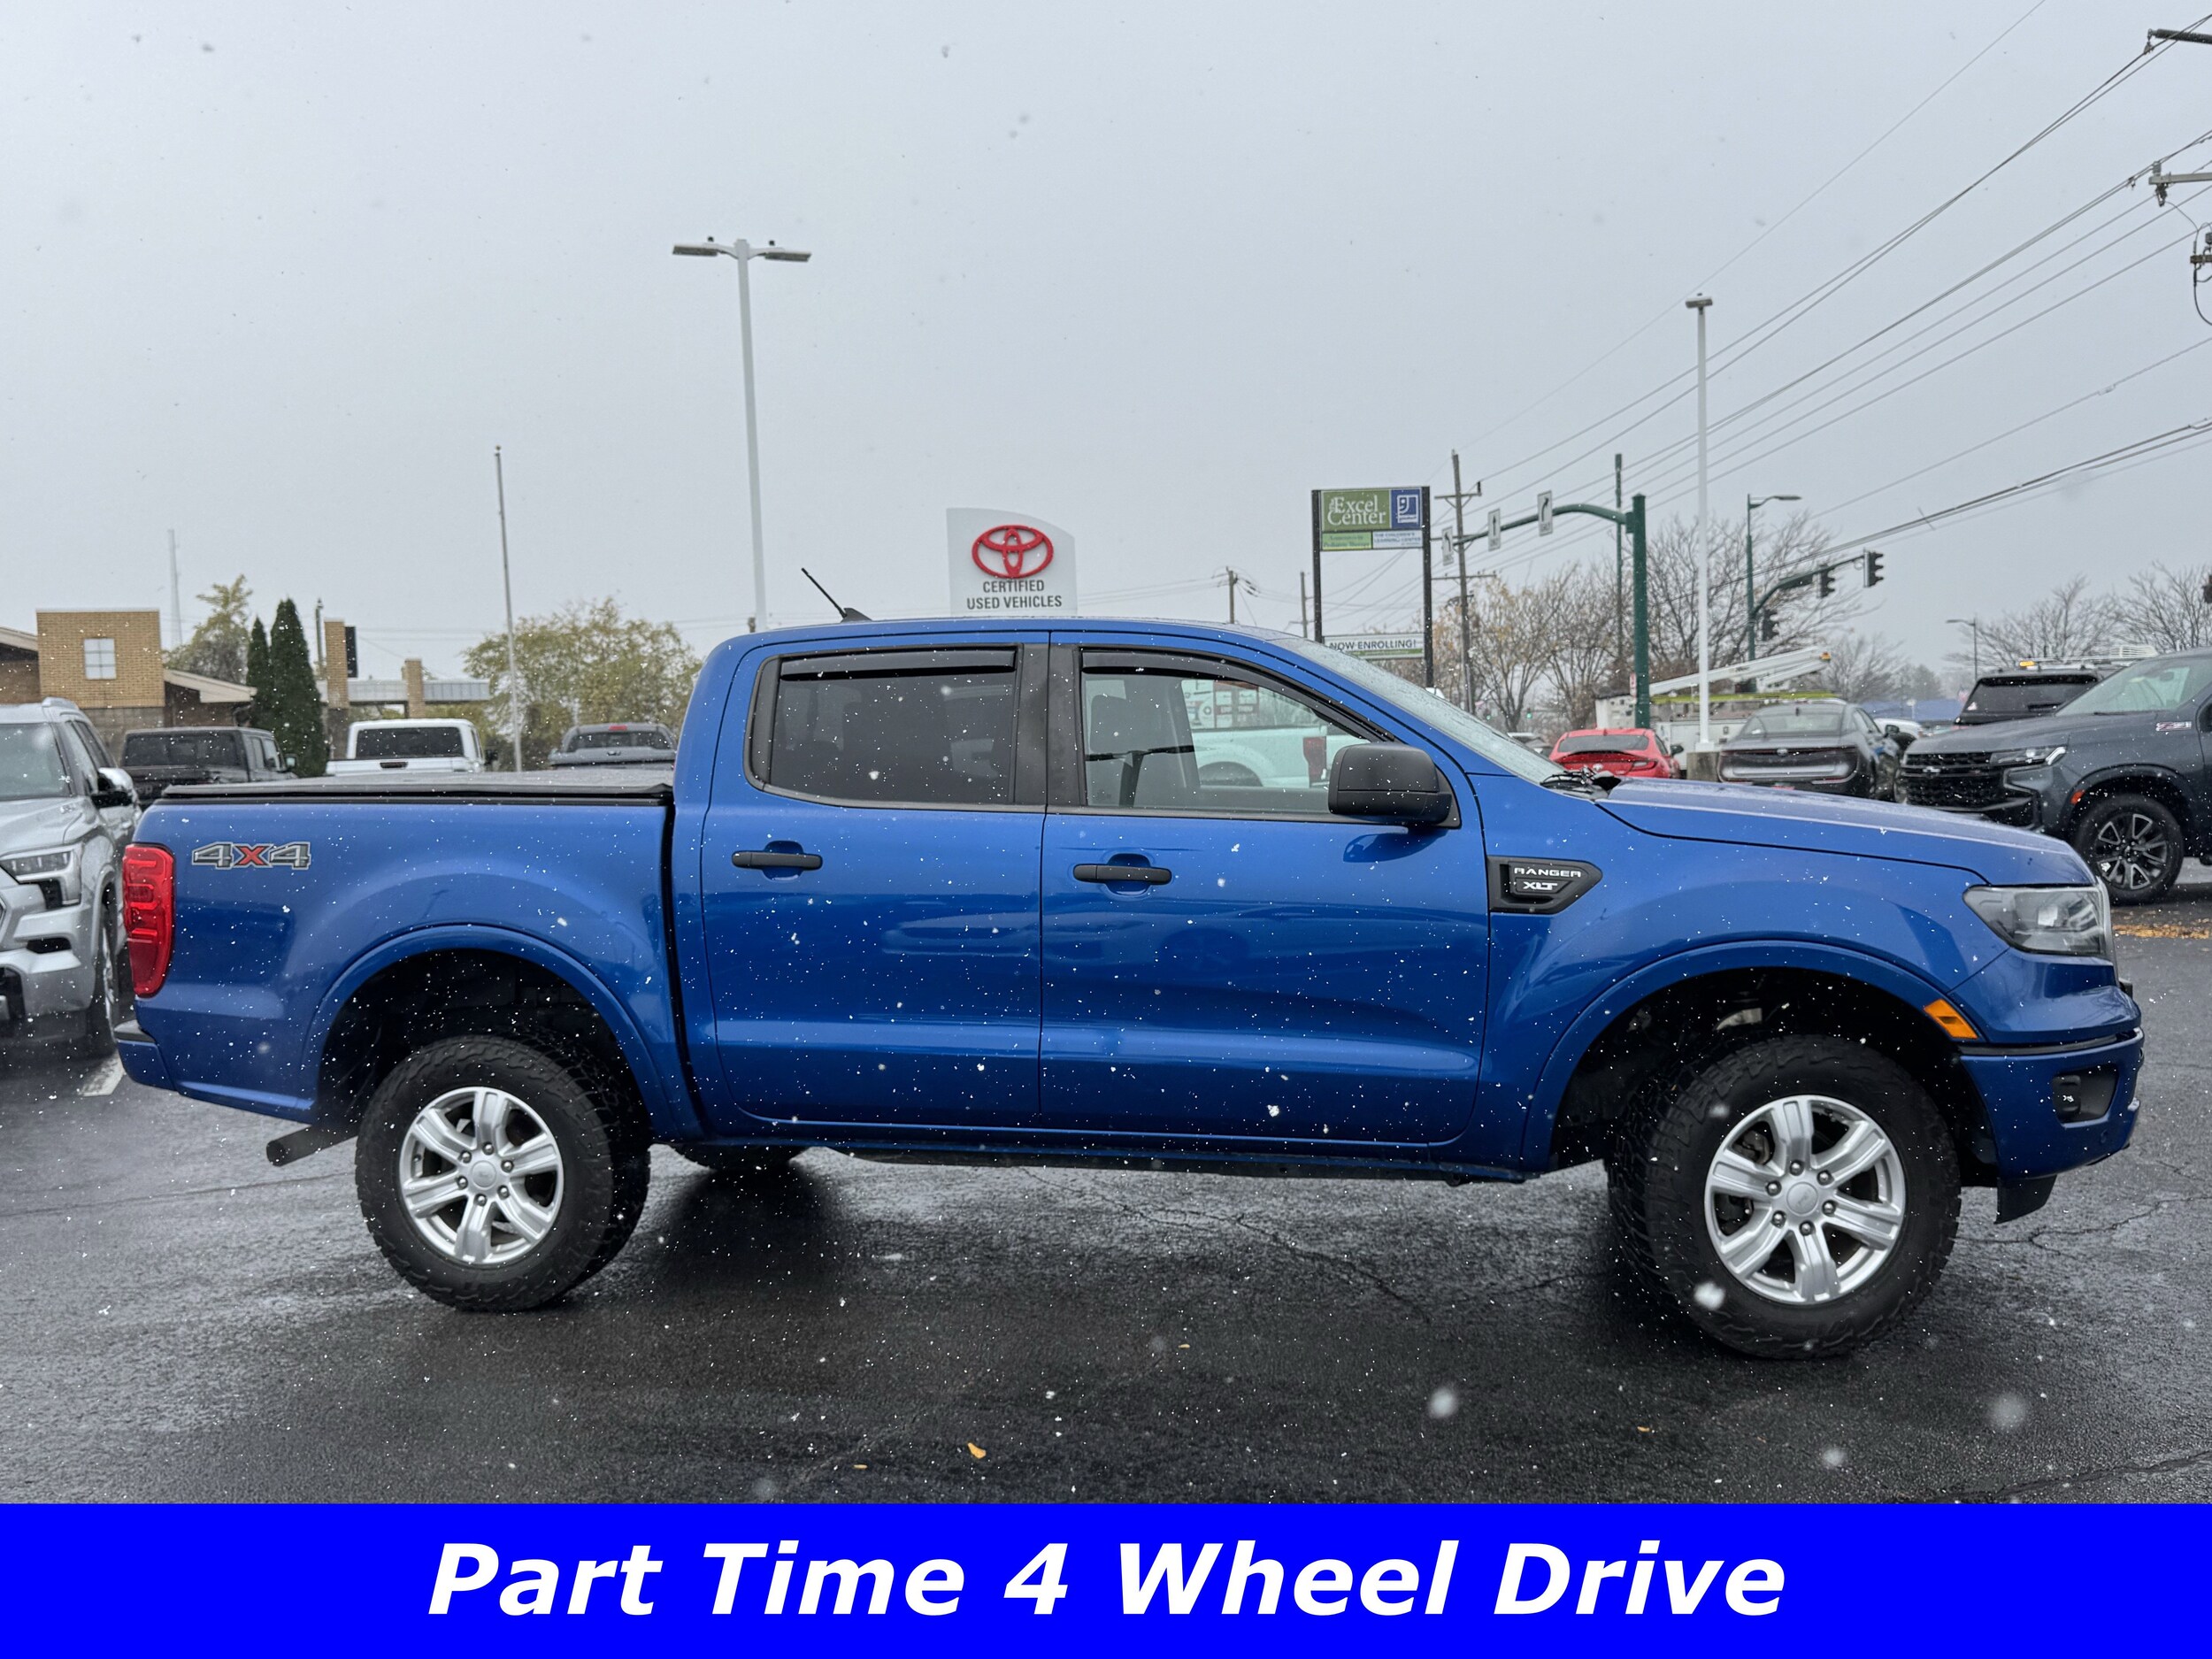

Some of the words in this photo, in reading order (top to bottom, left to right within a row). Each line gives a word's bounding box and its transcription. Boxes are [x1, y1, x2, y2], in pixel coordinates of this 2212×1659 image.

[1333, 495, 1378, 513] Excel
[1327, 510, 1386, 526] Center
[982, 580, 1045, 594] CERTIFIED
[966, 597, 1000, 610] USED
[1003, 595, 1062, 609] VEHICLES
[1330, 641, 1355, 651] NOW
[1357, 639, 1416, 649] ENROLLING!
[1514, 867, 1581, 878] RANGER
[1523, 881, 1557, 890] XLT
